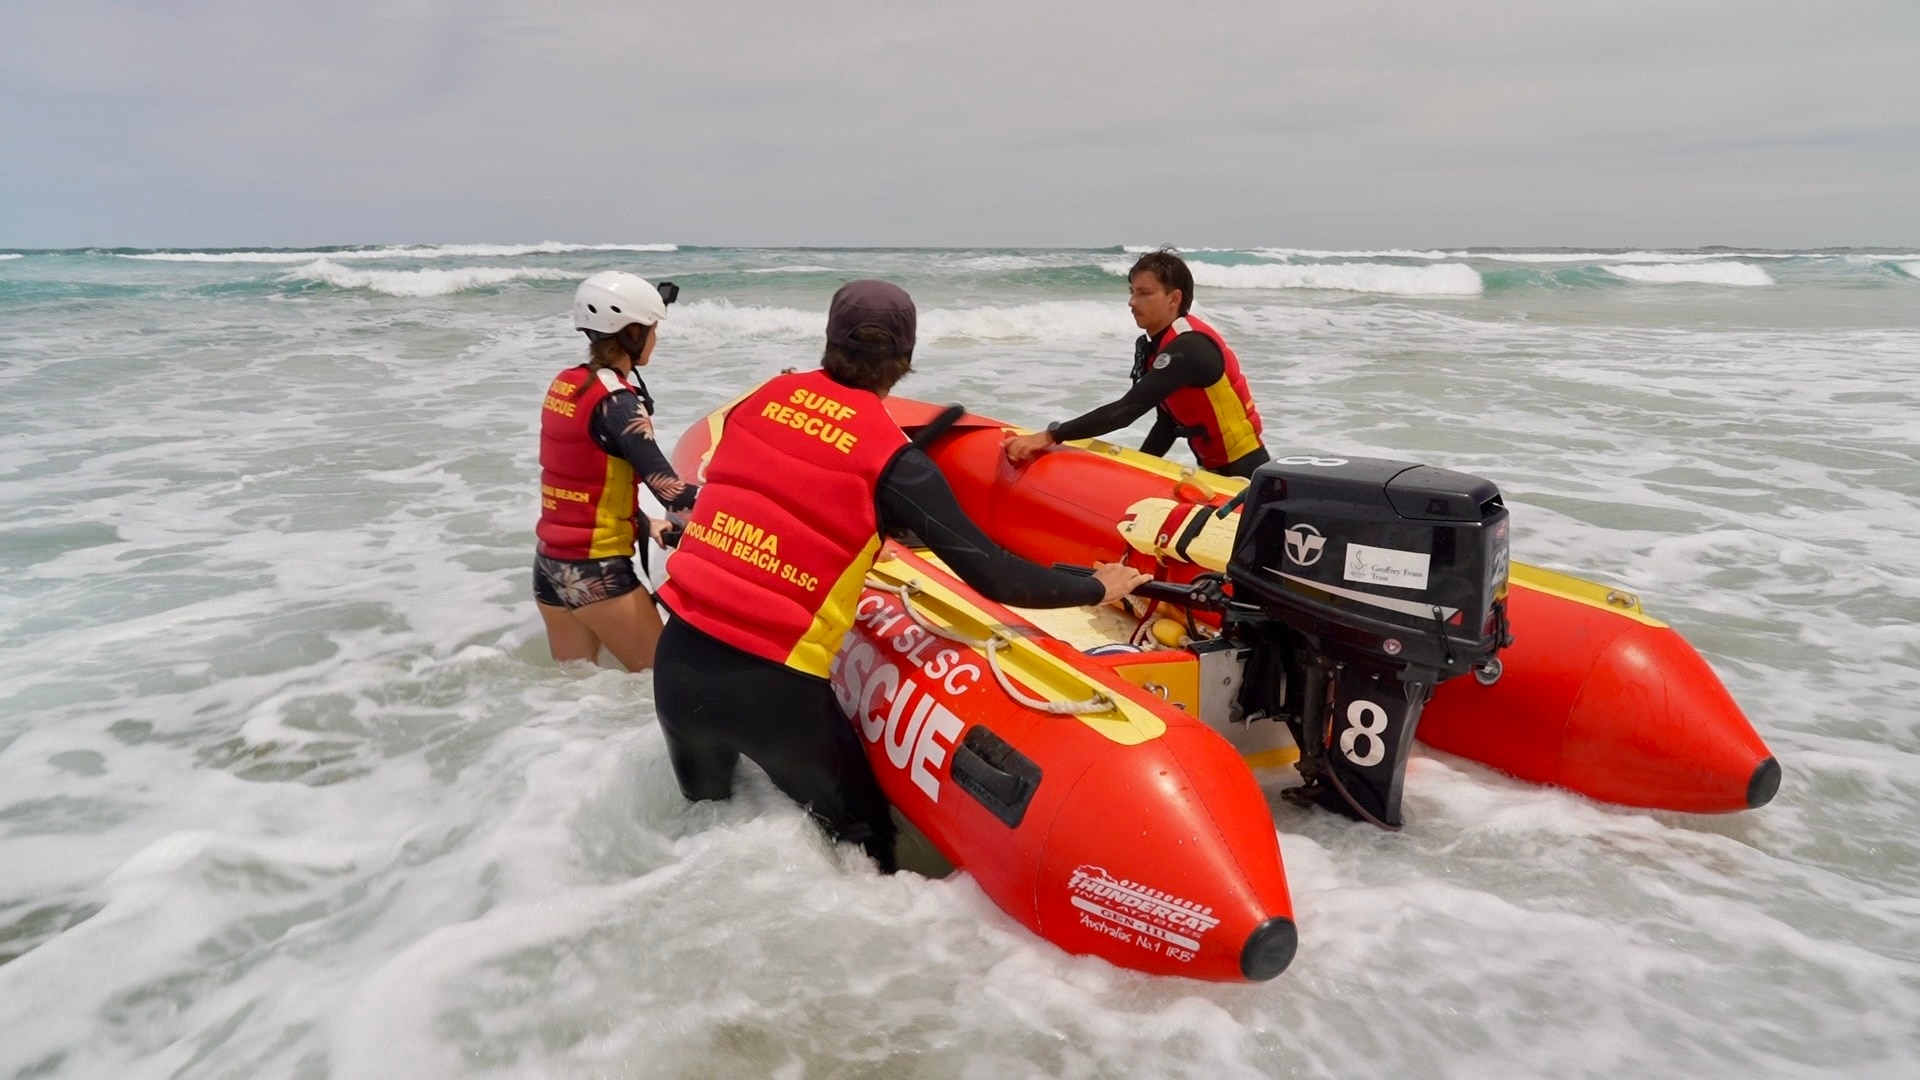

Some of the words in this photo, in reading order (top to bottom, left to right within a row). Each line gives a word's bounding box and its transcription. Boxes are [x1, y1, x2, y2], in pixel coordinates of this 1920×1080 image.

[544, 394, 577, 418] ESCUE
[761, 401, 858, 454] RESCUE
[789, 388, 857, 422] SURF
[711, 511, 778, 556] EMMA
[731, 541, 781, 574] BEACH
[781, 563, 819, 592] SLSC
[1371, 564, 1400, 577] Geoffrey
[1403, 568, 1423, 578] Evans
[1371, 572, 1389, 581] Trust
[856, 595, 906, 637] CH
[892, 624, 981, 695] SLSC
[1340, 699, 1388, 767] 8
[1068, 870, 1217, 933] THUNDERCAT
[1074, 888, 1203, 939] INFLATABLES
